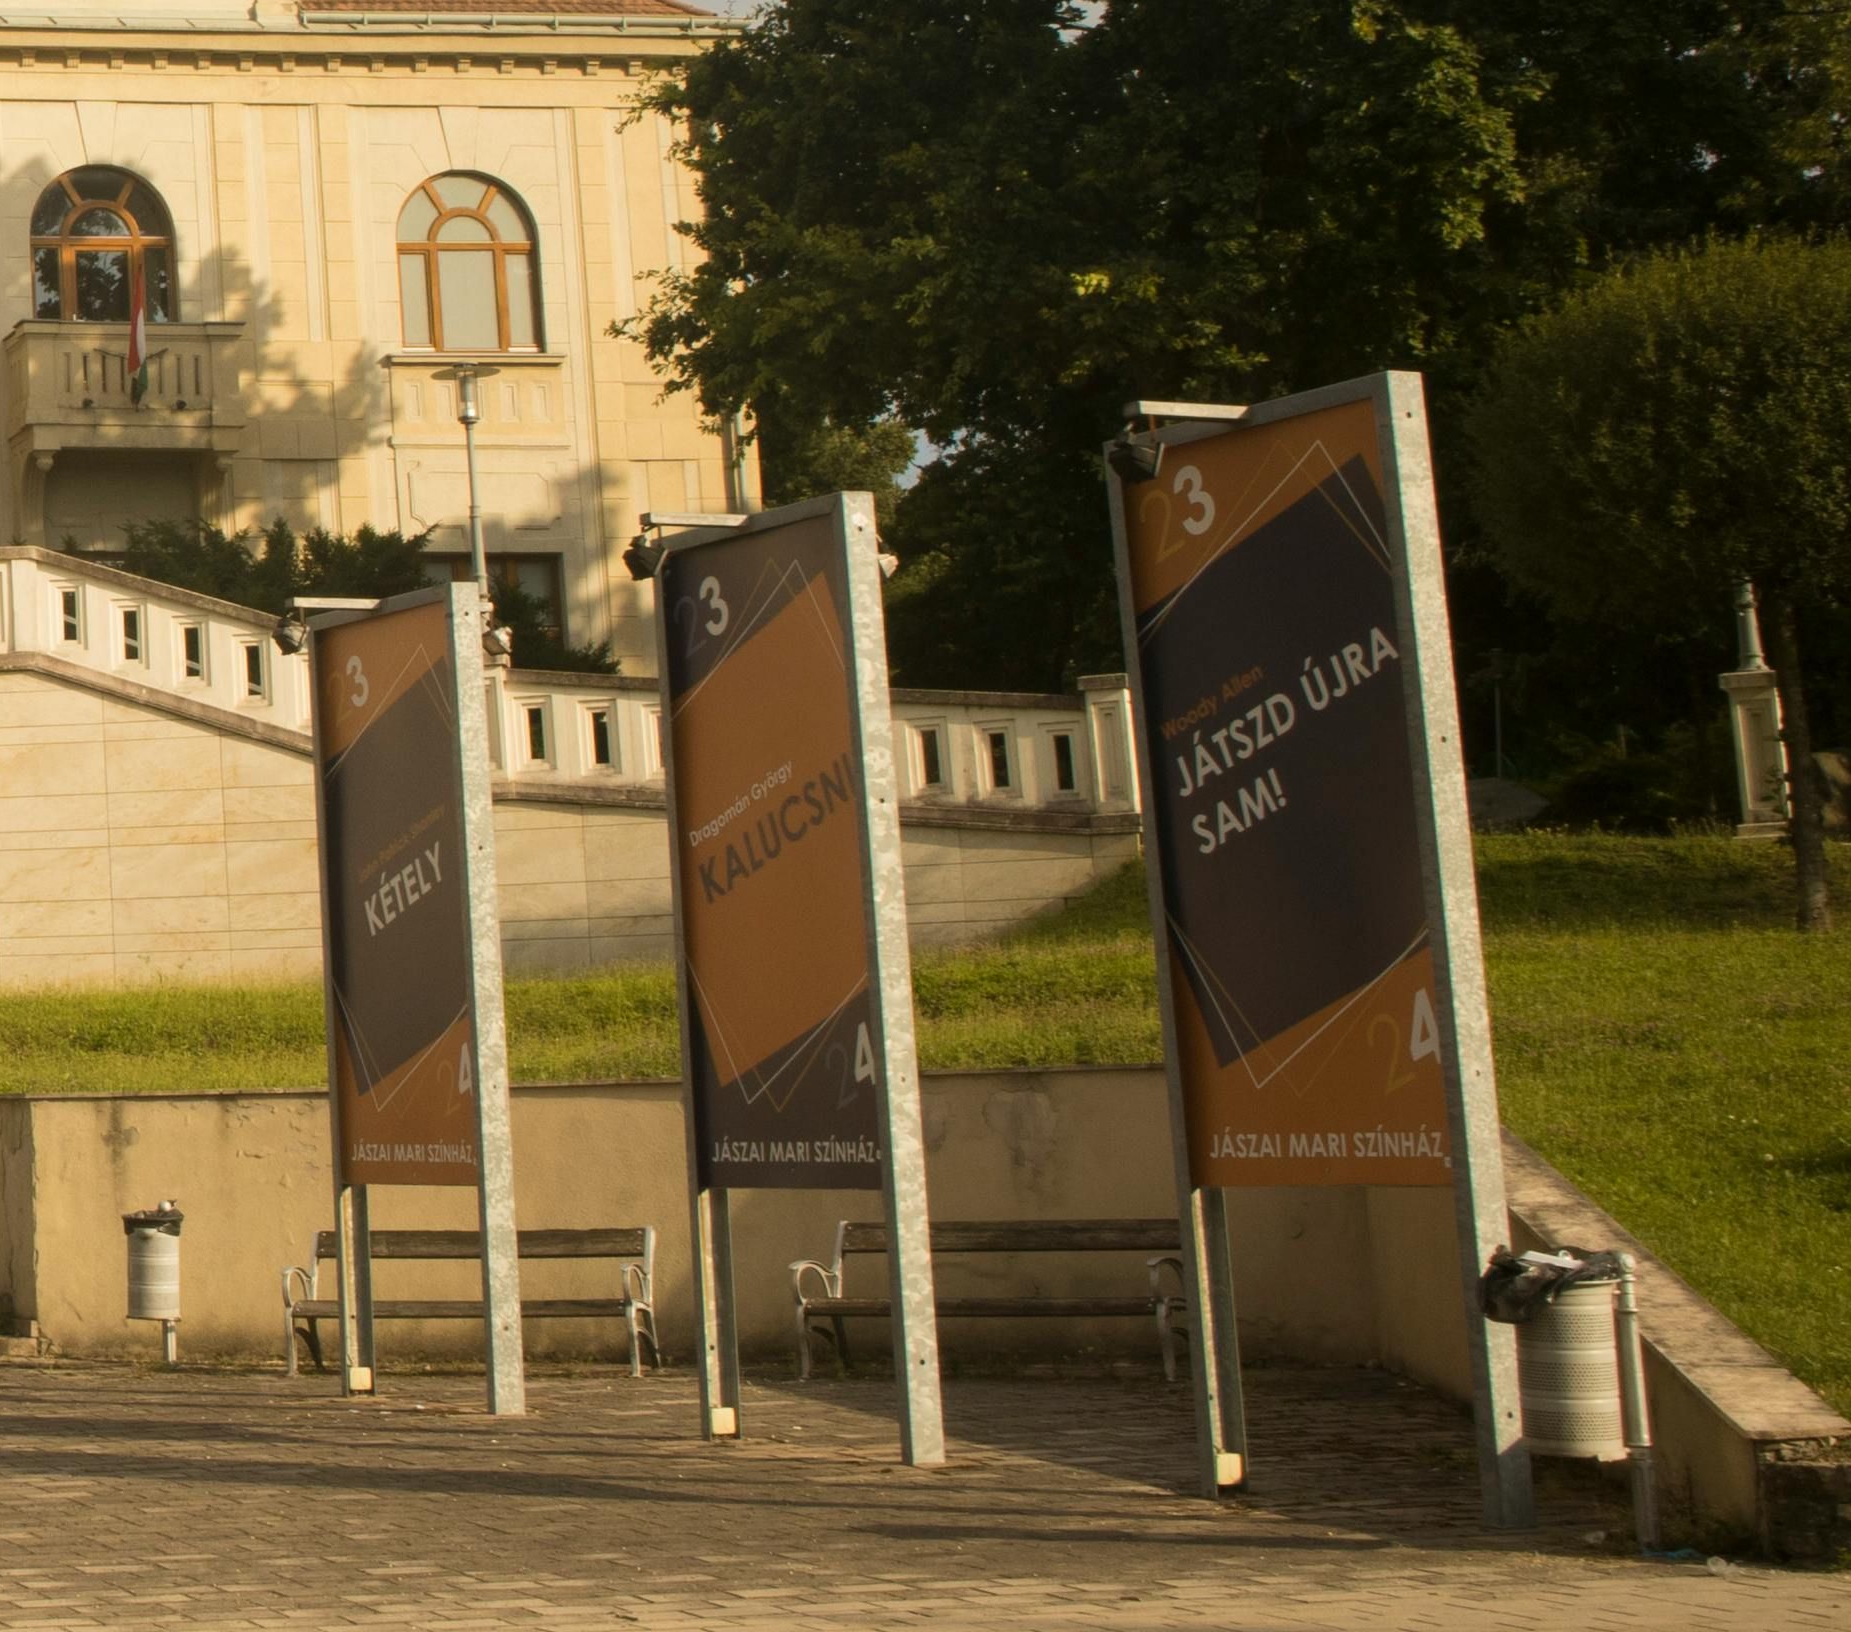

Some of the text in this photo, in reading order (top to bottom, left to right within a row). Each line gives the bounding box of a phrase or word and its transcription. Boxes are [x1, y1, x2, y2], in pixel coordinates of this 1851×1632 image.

[1140, 465, 1216, 565] 23
[1160, 665, 1267, 740] Woody Allen
[1176, 626, 1399, 798] JÁTSZD ÚJRA
[689, 760, 793, 847] Dragomán György
[1191, 768, 1287, 854] SAM!
[364, 840, 442, 937] KÉTELY
[352, 1138, 391, 1161] JÁSZAI
[394, 1144, 425, 1161] MARI
[711, 1135, 764, 1163] JÁSZAI
[769, 1141, 810, 1162] MARI
[1210, 1126, 1282, 1158] JÁSZAI
[1289, 1133, 1347, 1158] MARI
